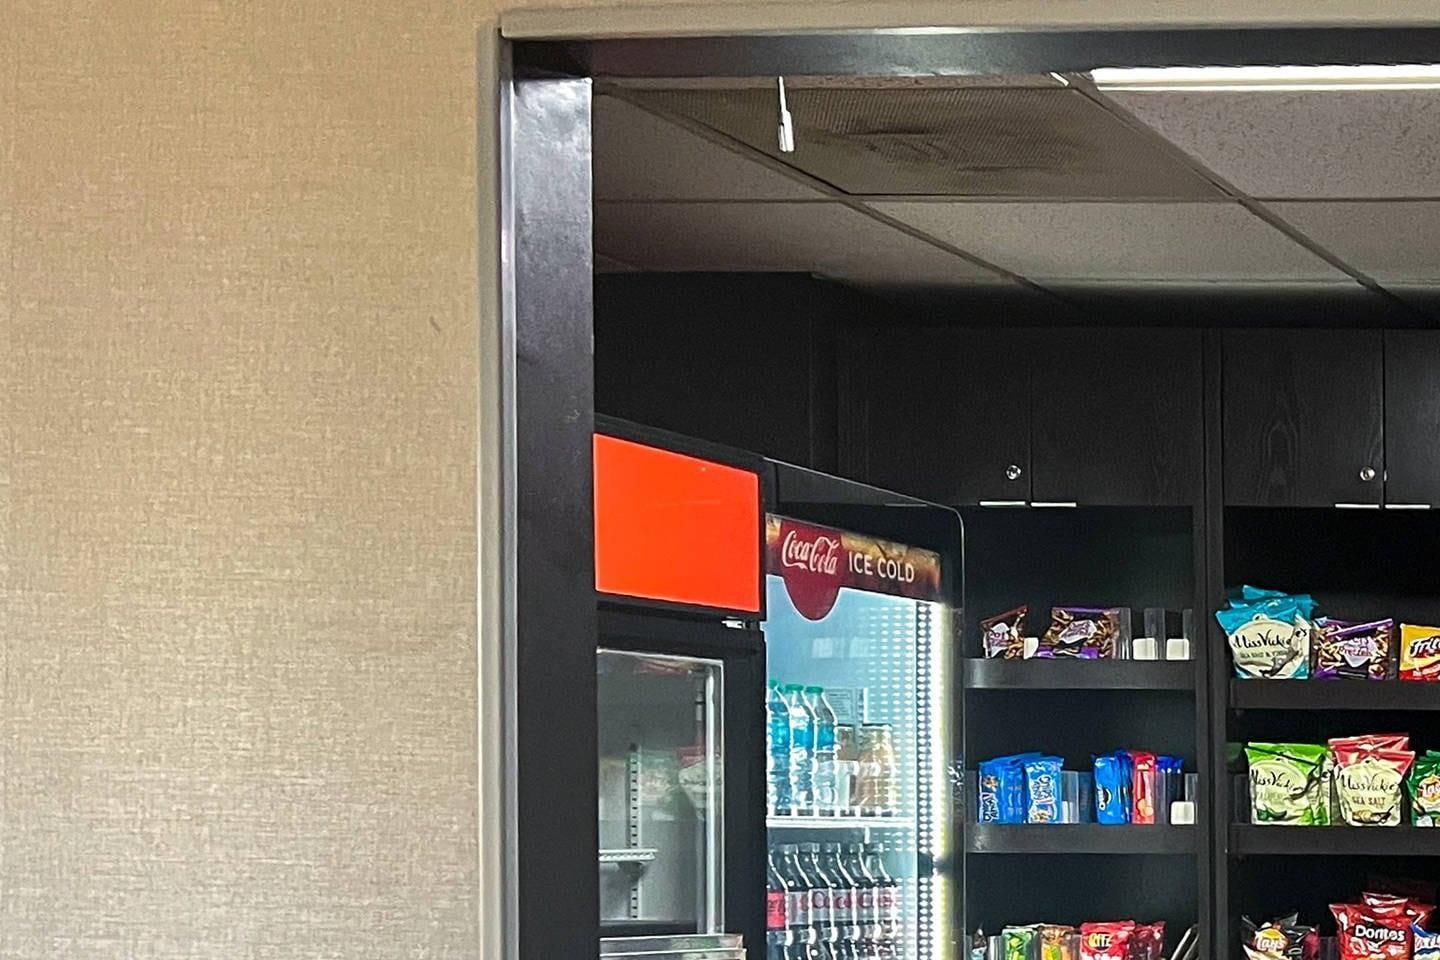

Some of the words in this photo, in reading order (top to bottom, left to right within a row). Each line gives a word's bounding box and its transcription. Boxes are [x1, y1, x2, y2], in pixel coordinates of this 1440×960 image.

[849, 551, 874, 576] ICE
[877, 559, 915, 583] COLD
[1352, 796, 1366, 806] SEA
[1368, 796, 1387, 806] SALT
[1355, 924, 1406, 942] Doritos
